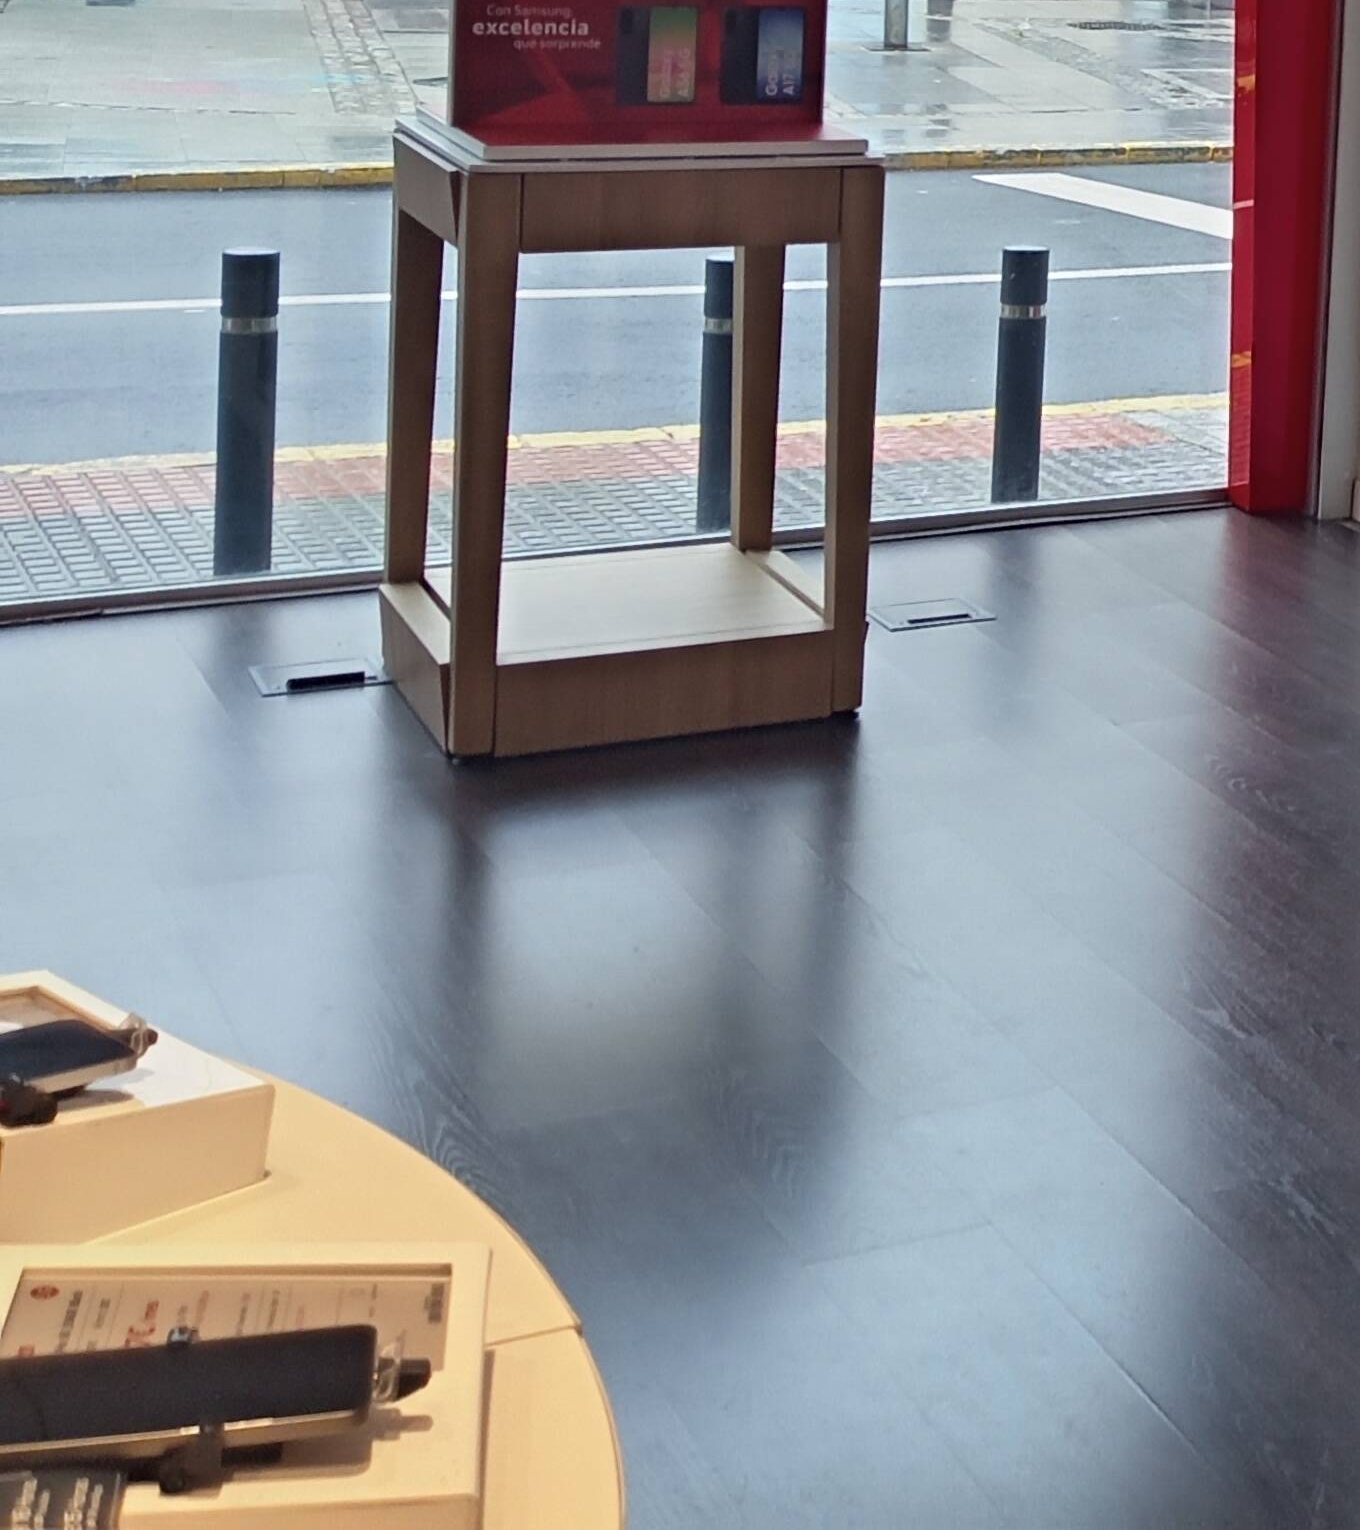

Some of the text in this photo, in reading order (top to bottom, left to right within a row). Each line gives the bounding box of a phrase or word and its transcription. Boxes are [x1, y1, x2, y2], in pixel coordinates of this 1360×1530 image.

[486, 4, 511, 16] Con
[472, 18, 590, 36] excelencia
[513, 38, 601, 51] que sorprende
